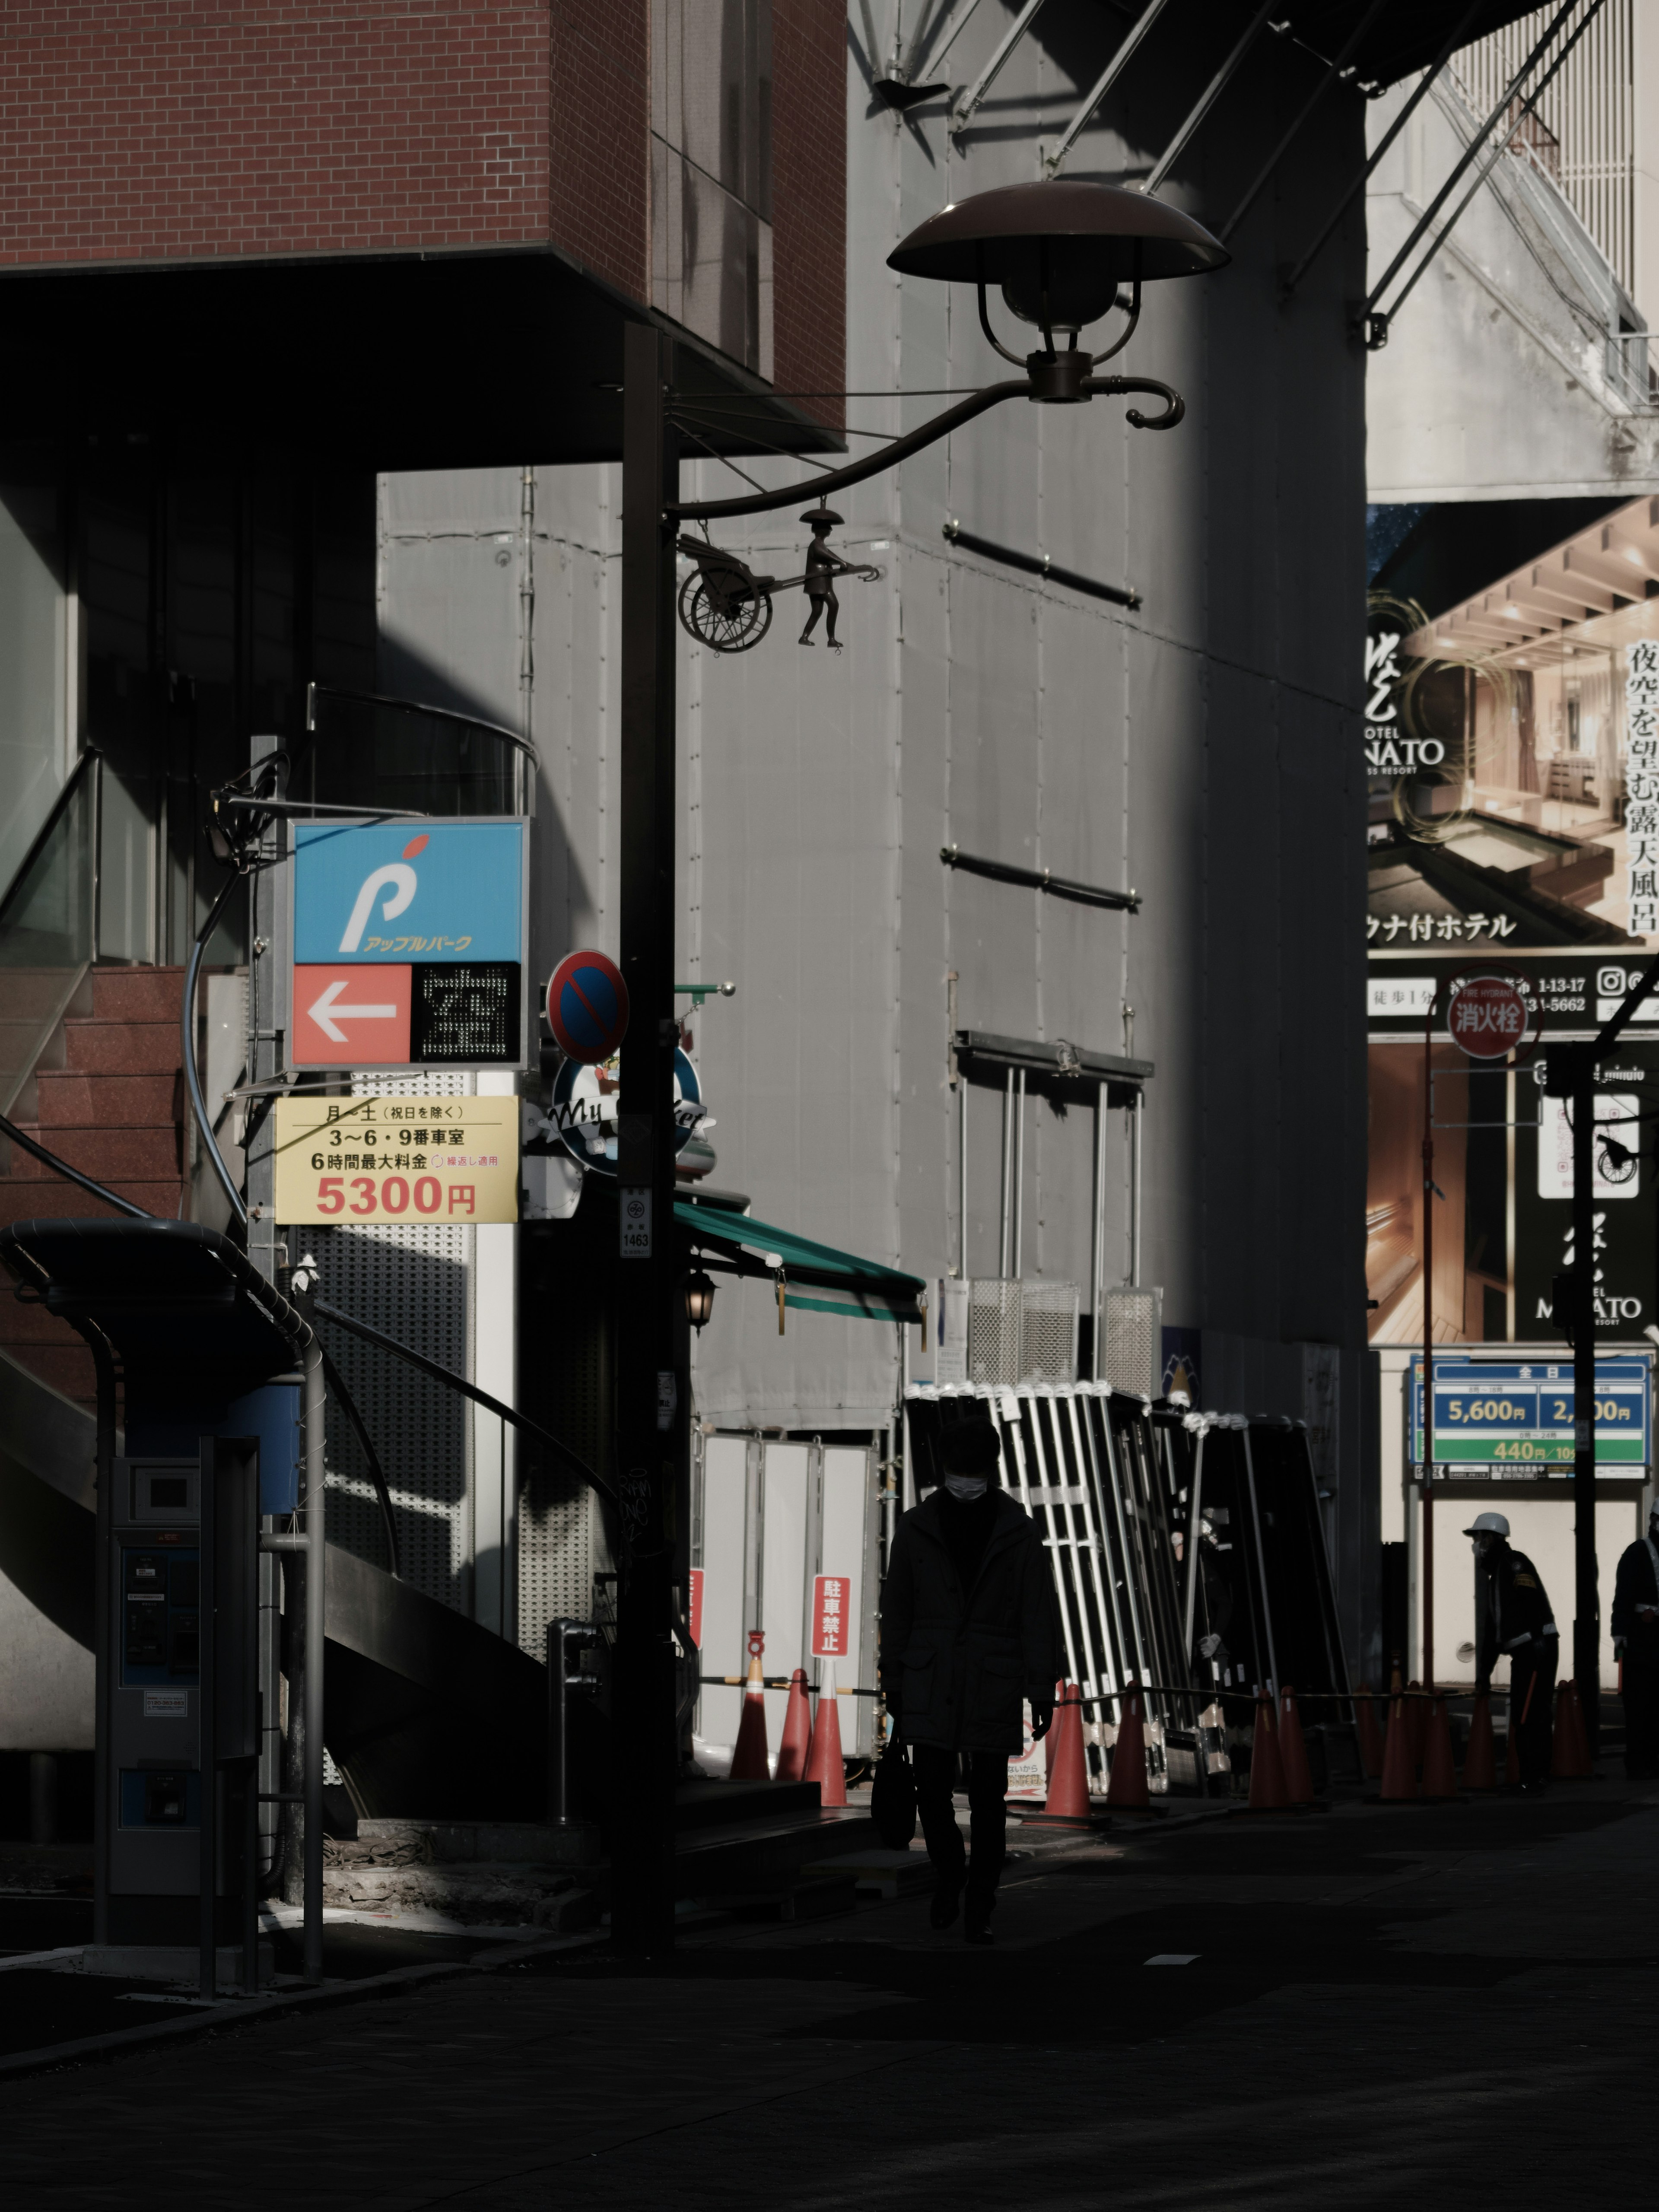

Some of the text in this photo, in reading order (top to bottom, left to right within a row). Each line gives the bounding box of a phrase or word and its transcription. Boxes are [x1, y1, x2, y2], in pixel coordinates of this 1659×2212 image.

[1630, 642, 1658, 932] 夜空を望む露天風呂
[364, 936, 472, 952] アップルパーク
[1463, 989, 1513, 998] FIRE HYDRANT
[1539, 978, 1586, 992] 1-13-17
[1456, 1003, 1521, 1033] 消火栓
[547, 1098, 602, 1130] My
[311, 1153, 498, 1170] 6時間最大料金 繰返し適用
[316, 1176, 475, 1215] 5300円
[624, 1234, 648, 1246] 1463
[1535, 1297, 1642, 1319] MATO
[1519, 1366, 1559, 1379] 全日
[1448, 1400, 1526, 1423] 5,600円
[1553, 1400, 1631, 1423] 2,00円
[822, 1580, 841, 1652] 駐車禁止
